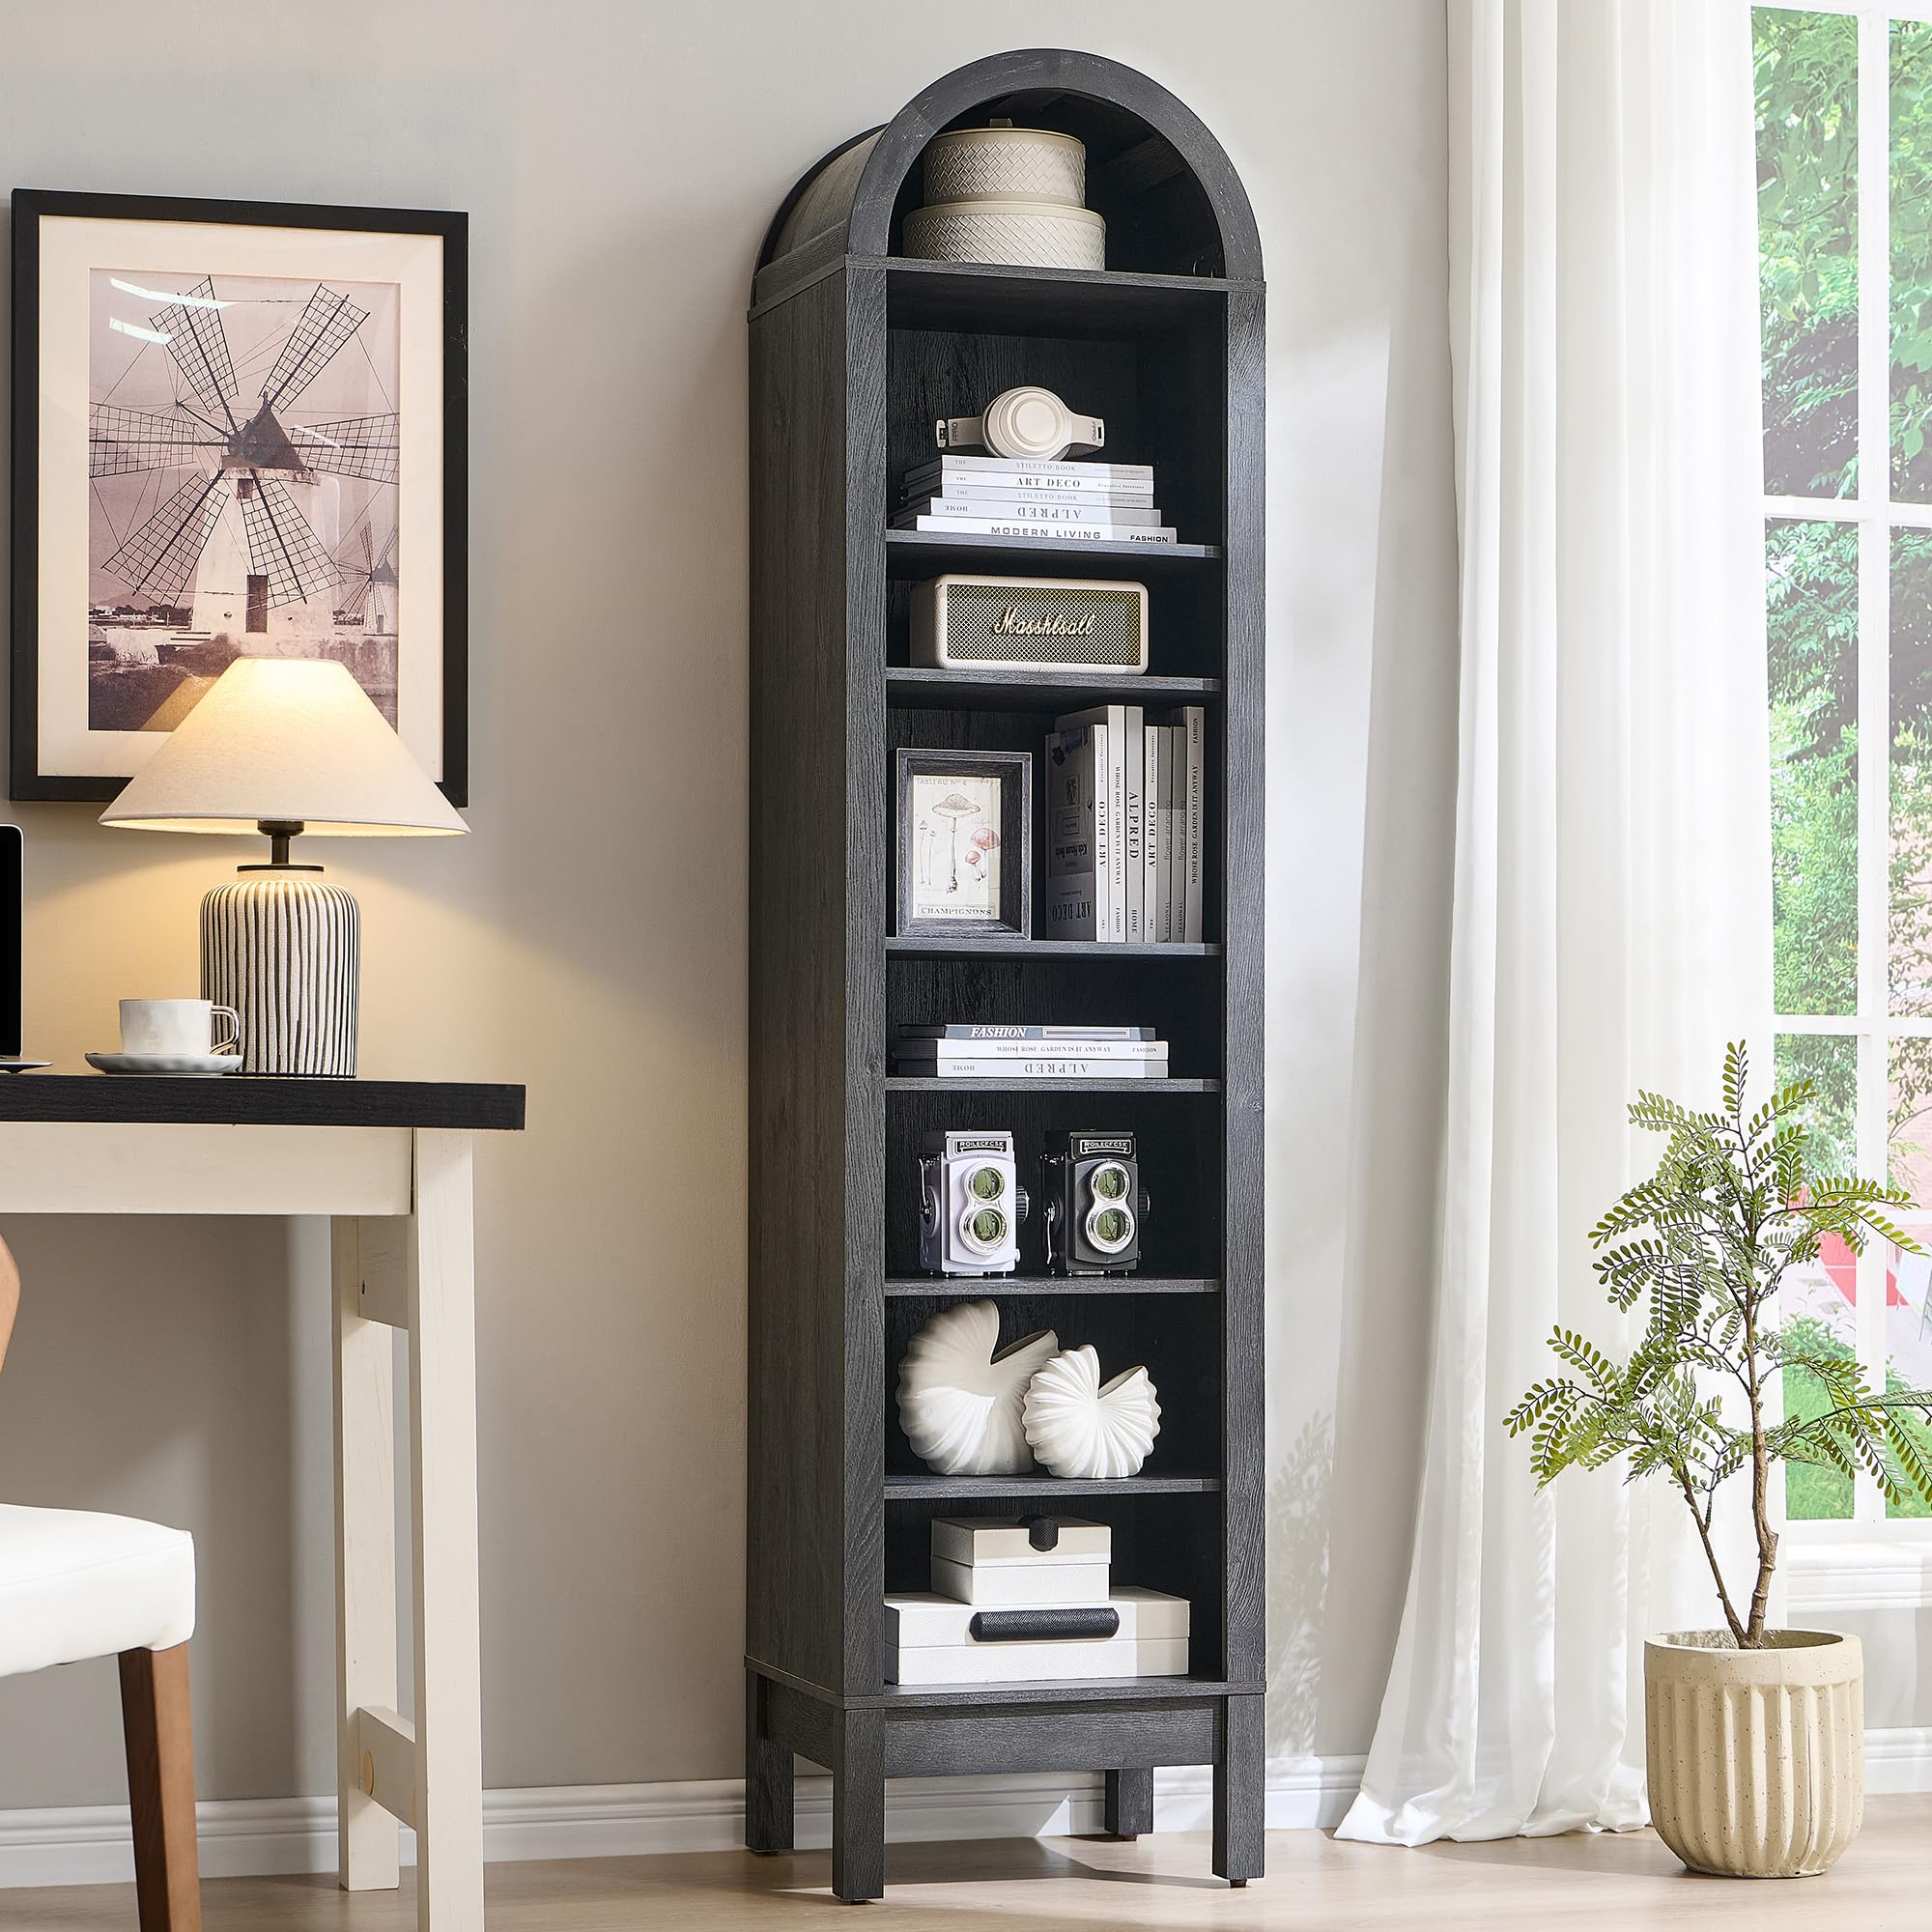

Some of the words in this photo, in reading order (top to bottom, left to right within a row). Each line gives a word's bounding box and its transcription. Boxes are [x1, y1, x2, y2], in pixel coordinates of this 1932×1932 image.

[1017, 477, 1040, 486] ART
[1047, 478, 1080, 488] DECO
[1017, 507, 1081, 519] ALPRED
[991, 526, 1048, 537] MODERN
[1056, 529, 1101, 540] LIVING
[1129, 792, 1139, 859] ALPRED
[1148, 801, 1156, 836] DECO
[1052, 903, 1073, 922] DECO
[1076, 901, 1092, 918] ART
[970, 1027, 1027, 1037] FASHION
[1025, 1064, 1088, 1073] ALPRED
